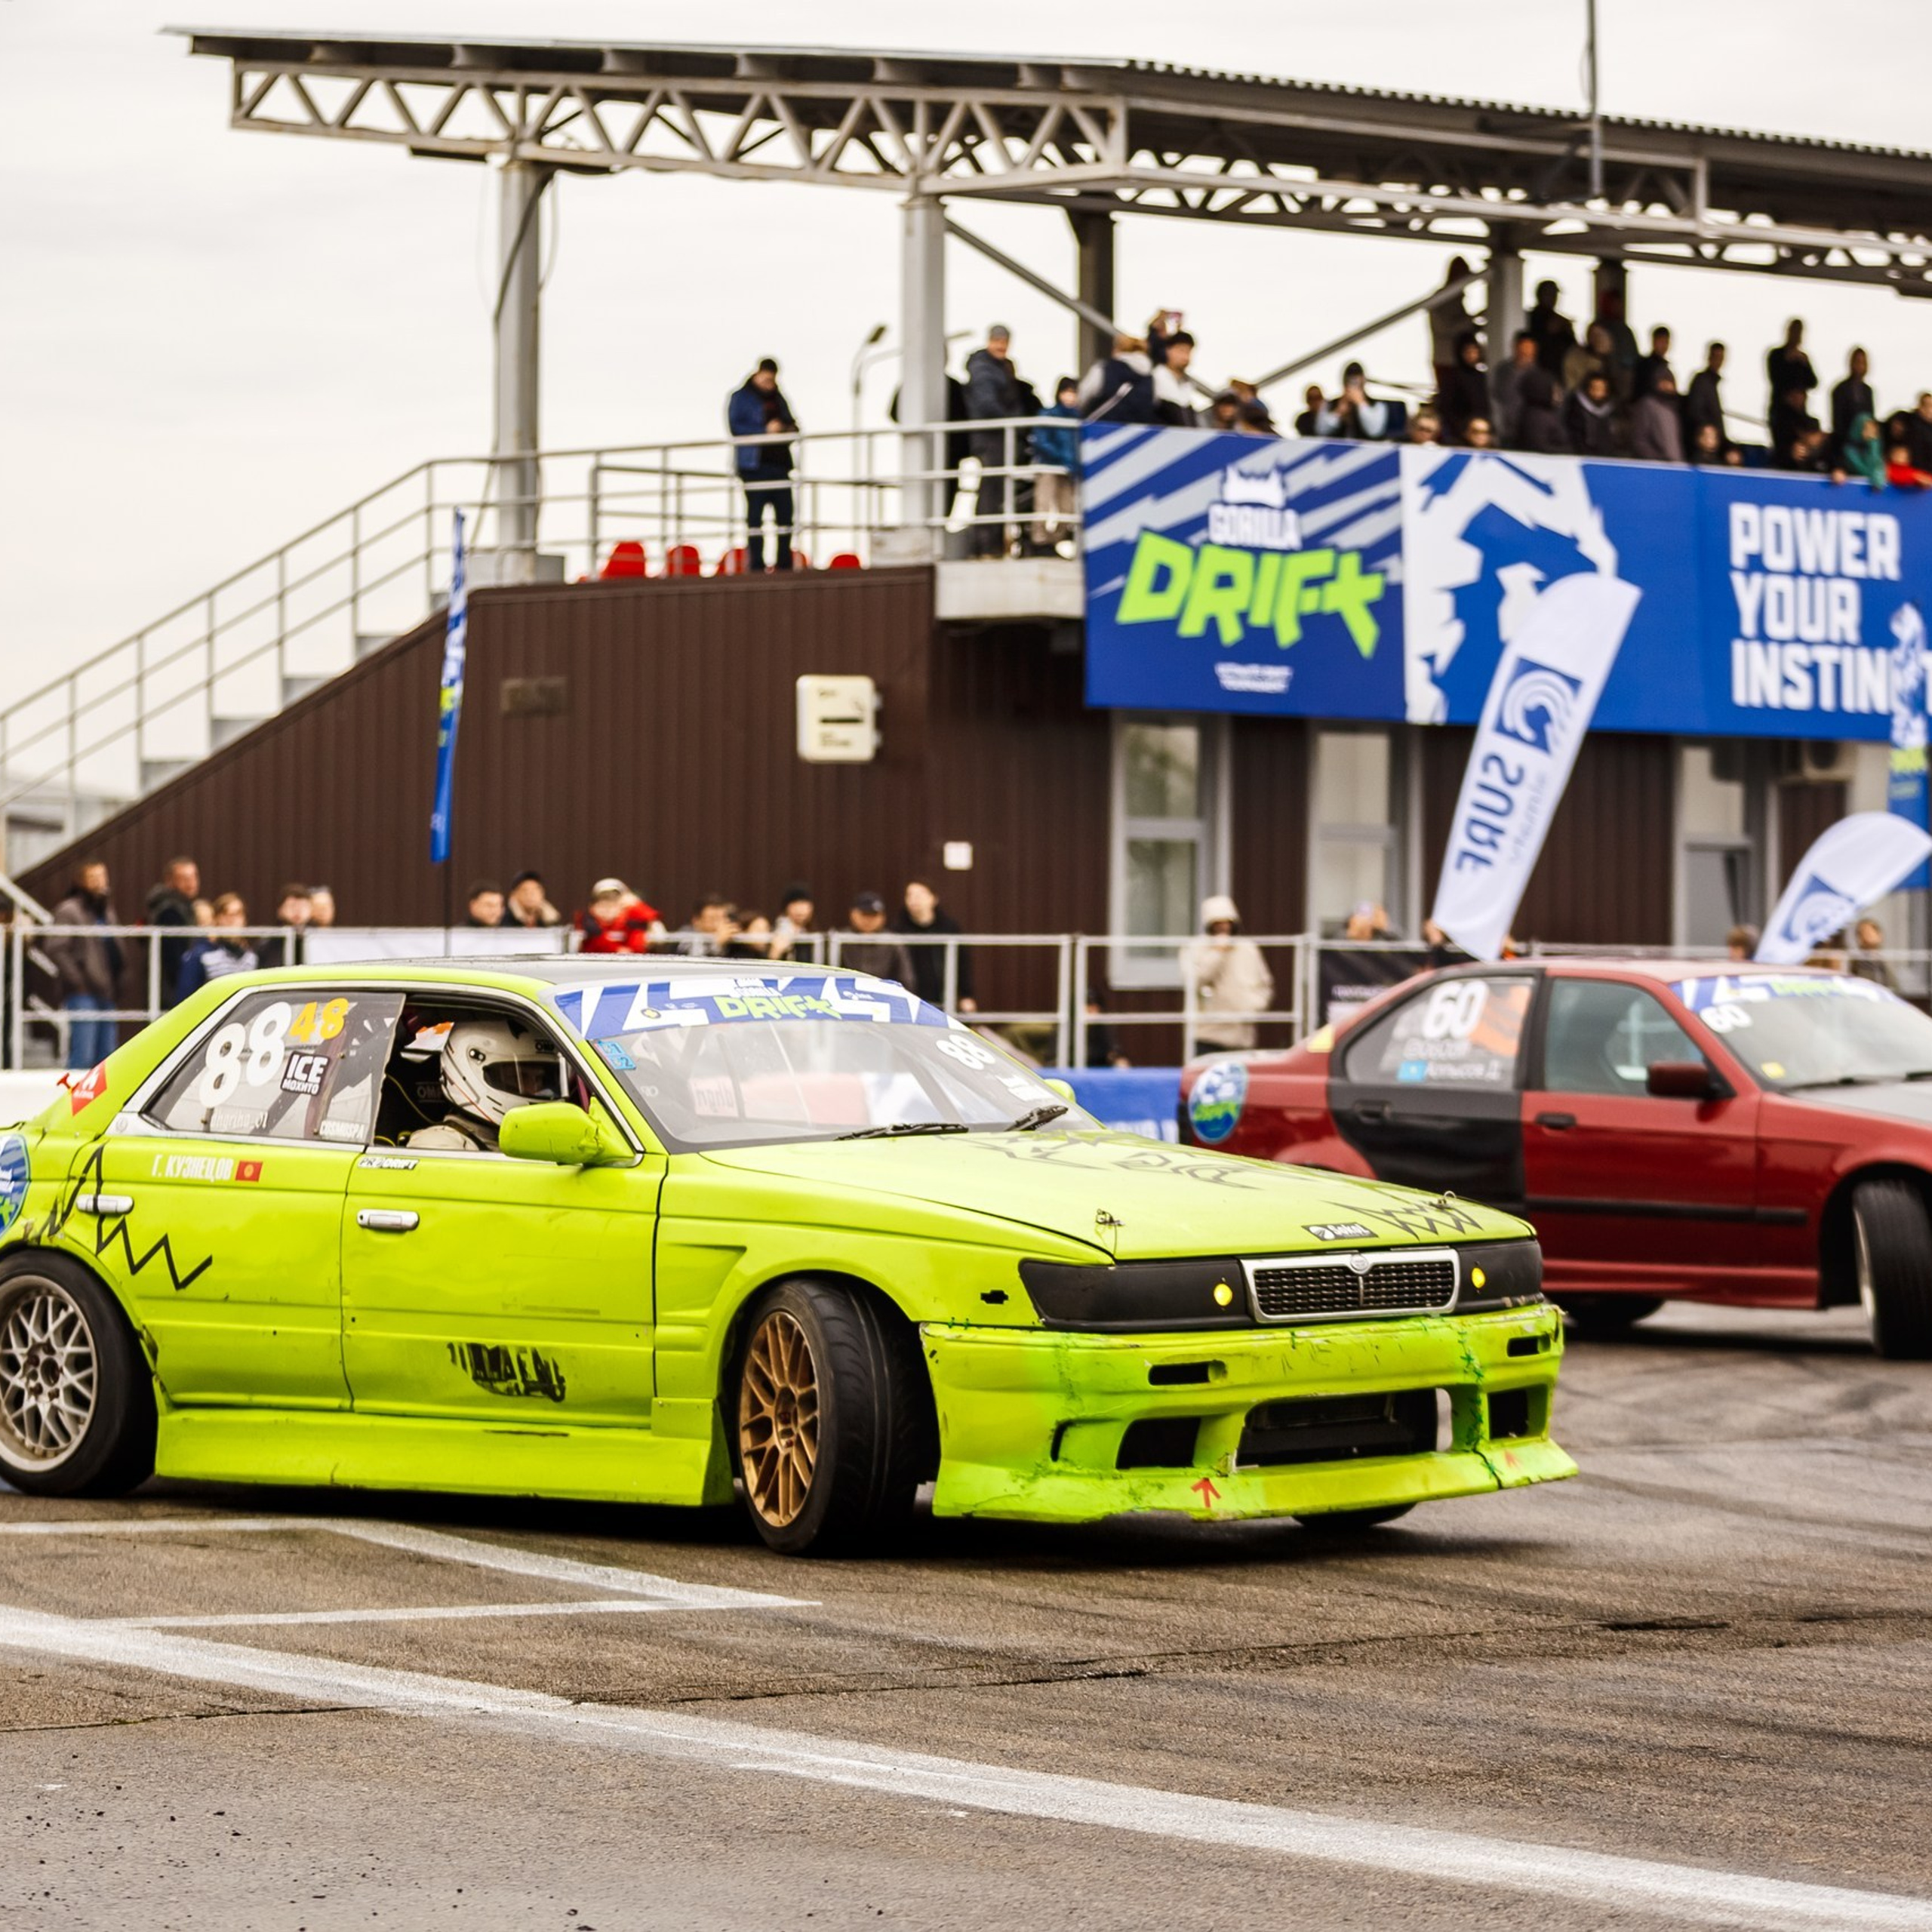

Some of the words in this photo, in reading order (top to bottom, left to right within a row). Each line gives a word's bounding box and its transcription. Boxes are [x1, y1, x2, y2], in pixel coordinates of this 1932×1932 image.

[1730, 502, 1901, 581] POWER
[1115, 530, 1386, 660] DRIFT
[1730, 571, 1862, 645] YOUR
[1732, 638, 1932, 715] INSTIN
[290, 998, 349, 1042] 48
[713, 995, 842, 1020] DRIFT
[1423, 980, 1490, 1038] 60
[198, 1001, 292, 1109] 88
[286, 1054, 328, 1083] ICE
[937, 1035, 995, 1070] 88
[281, 1078, 319, 1095] МОХИТО
[165, 1155, 234, 1183] КУЗНЕЦОВ
